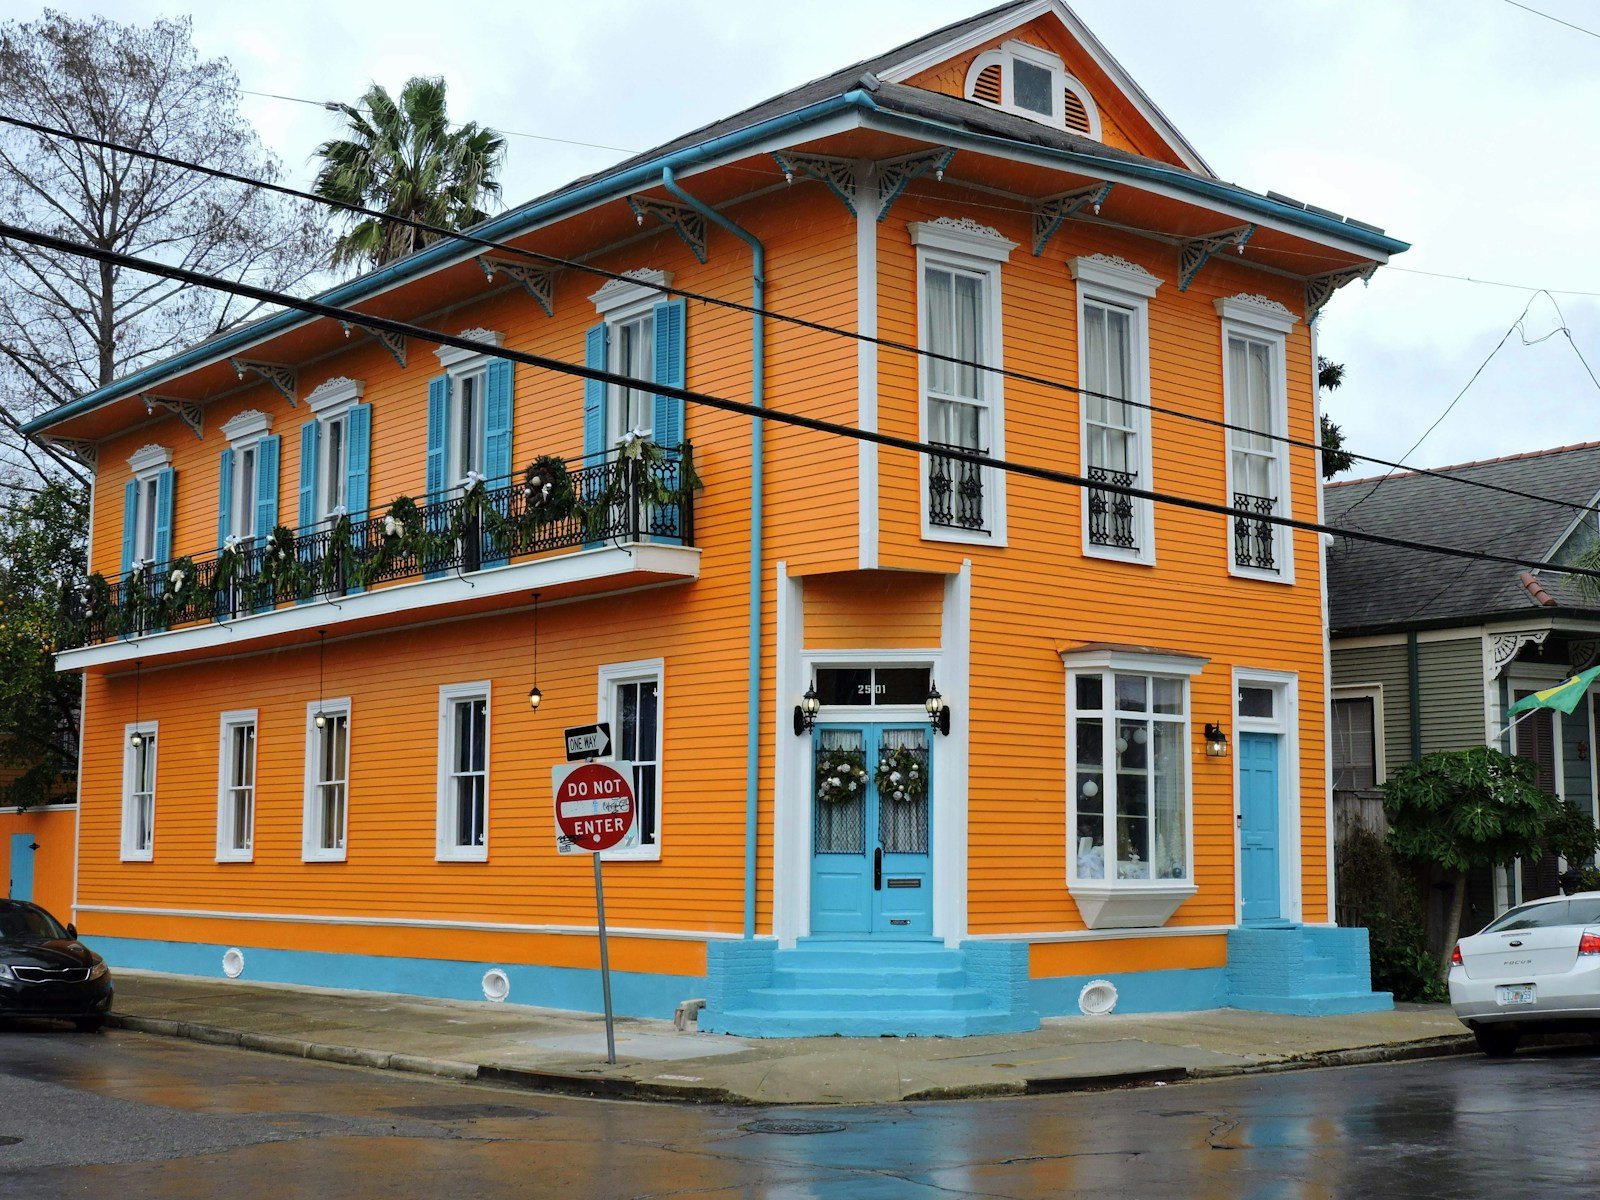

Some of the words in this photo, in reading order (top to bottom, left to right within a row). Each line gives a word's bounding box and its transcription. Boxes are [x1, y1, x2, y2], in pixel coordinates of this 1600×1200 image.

[857, 684, 886, 694] 2501
[569, 737, 582, 751] ONE
[584, 735, 597, 749] WAY
[568, 781, 588, 797] DO
[594, 779, 622, 794] NOT
[574, 818, 624, 835] ENTER
